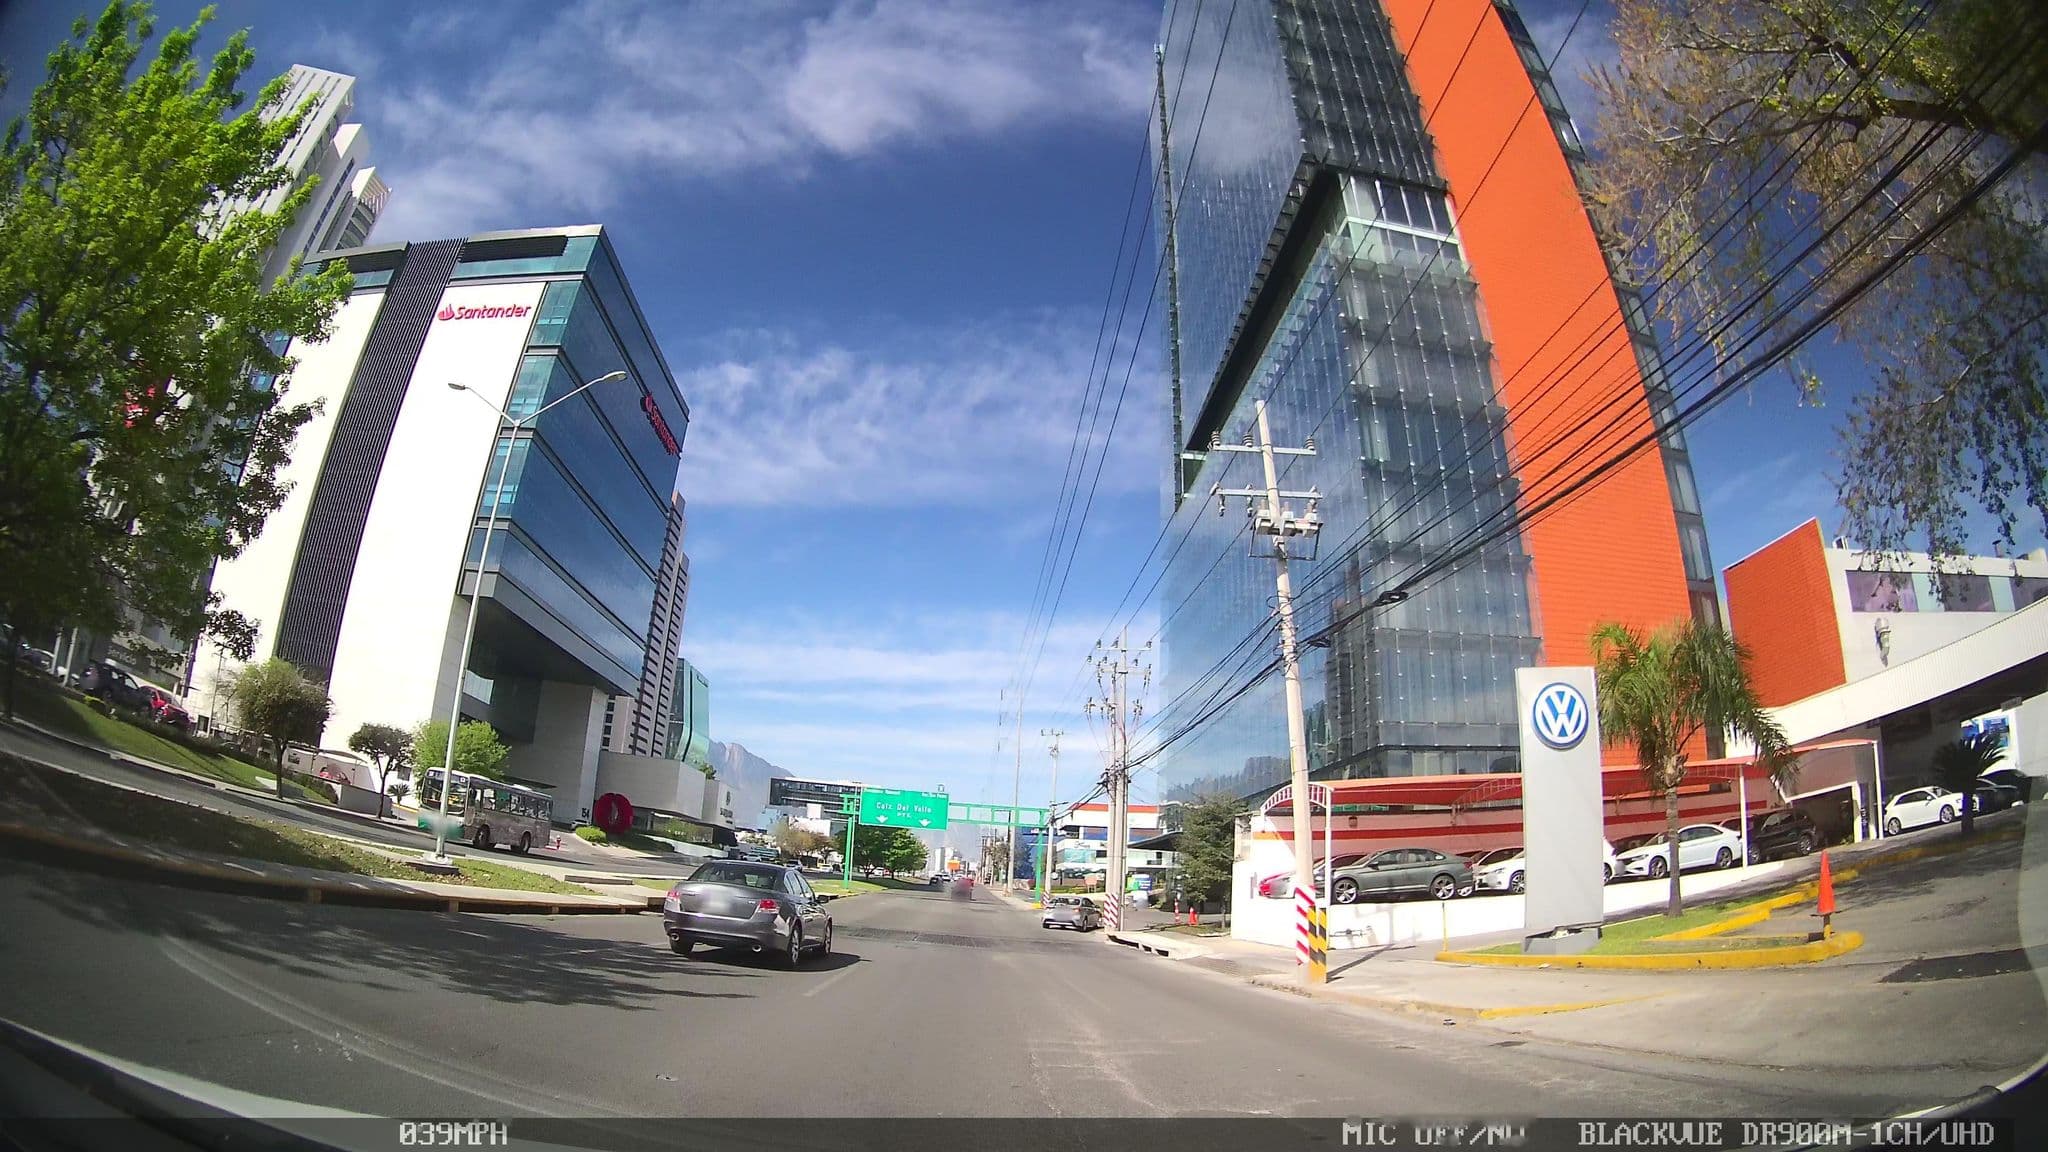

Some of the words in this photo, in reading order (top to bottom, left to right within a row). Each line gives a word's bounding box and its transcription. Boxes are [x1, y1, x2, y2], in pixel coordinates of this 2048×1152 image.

[455, 304, 532, 320] Santander
[896, 803, 910, 812] Del
[914, 805, 932, 813] Valle
